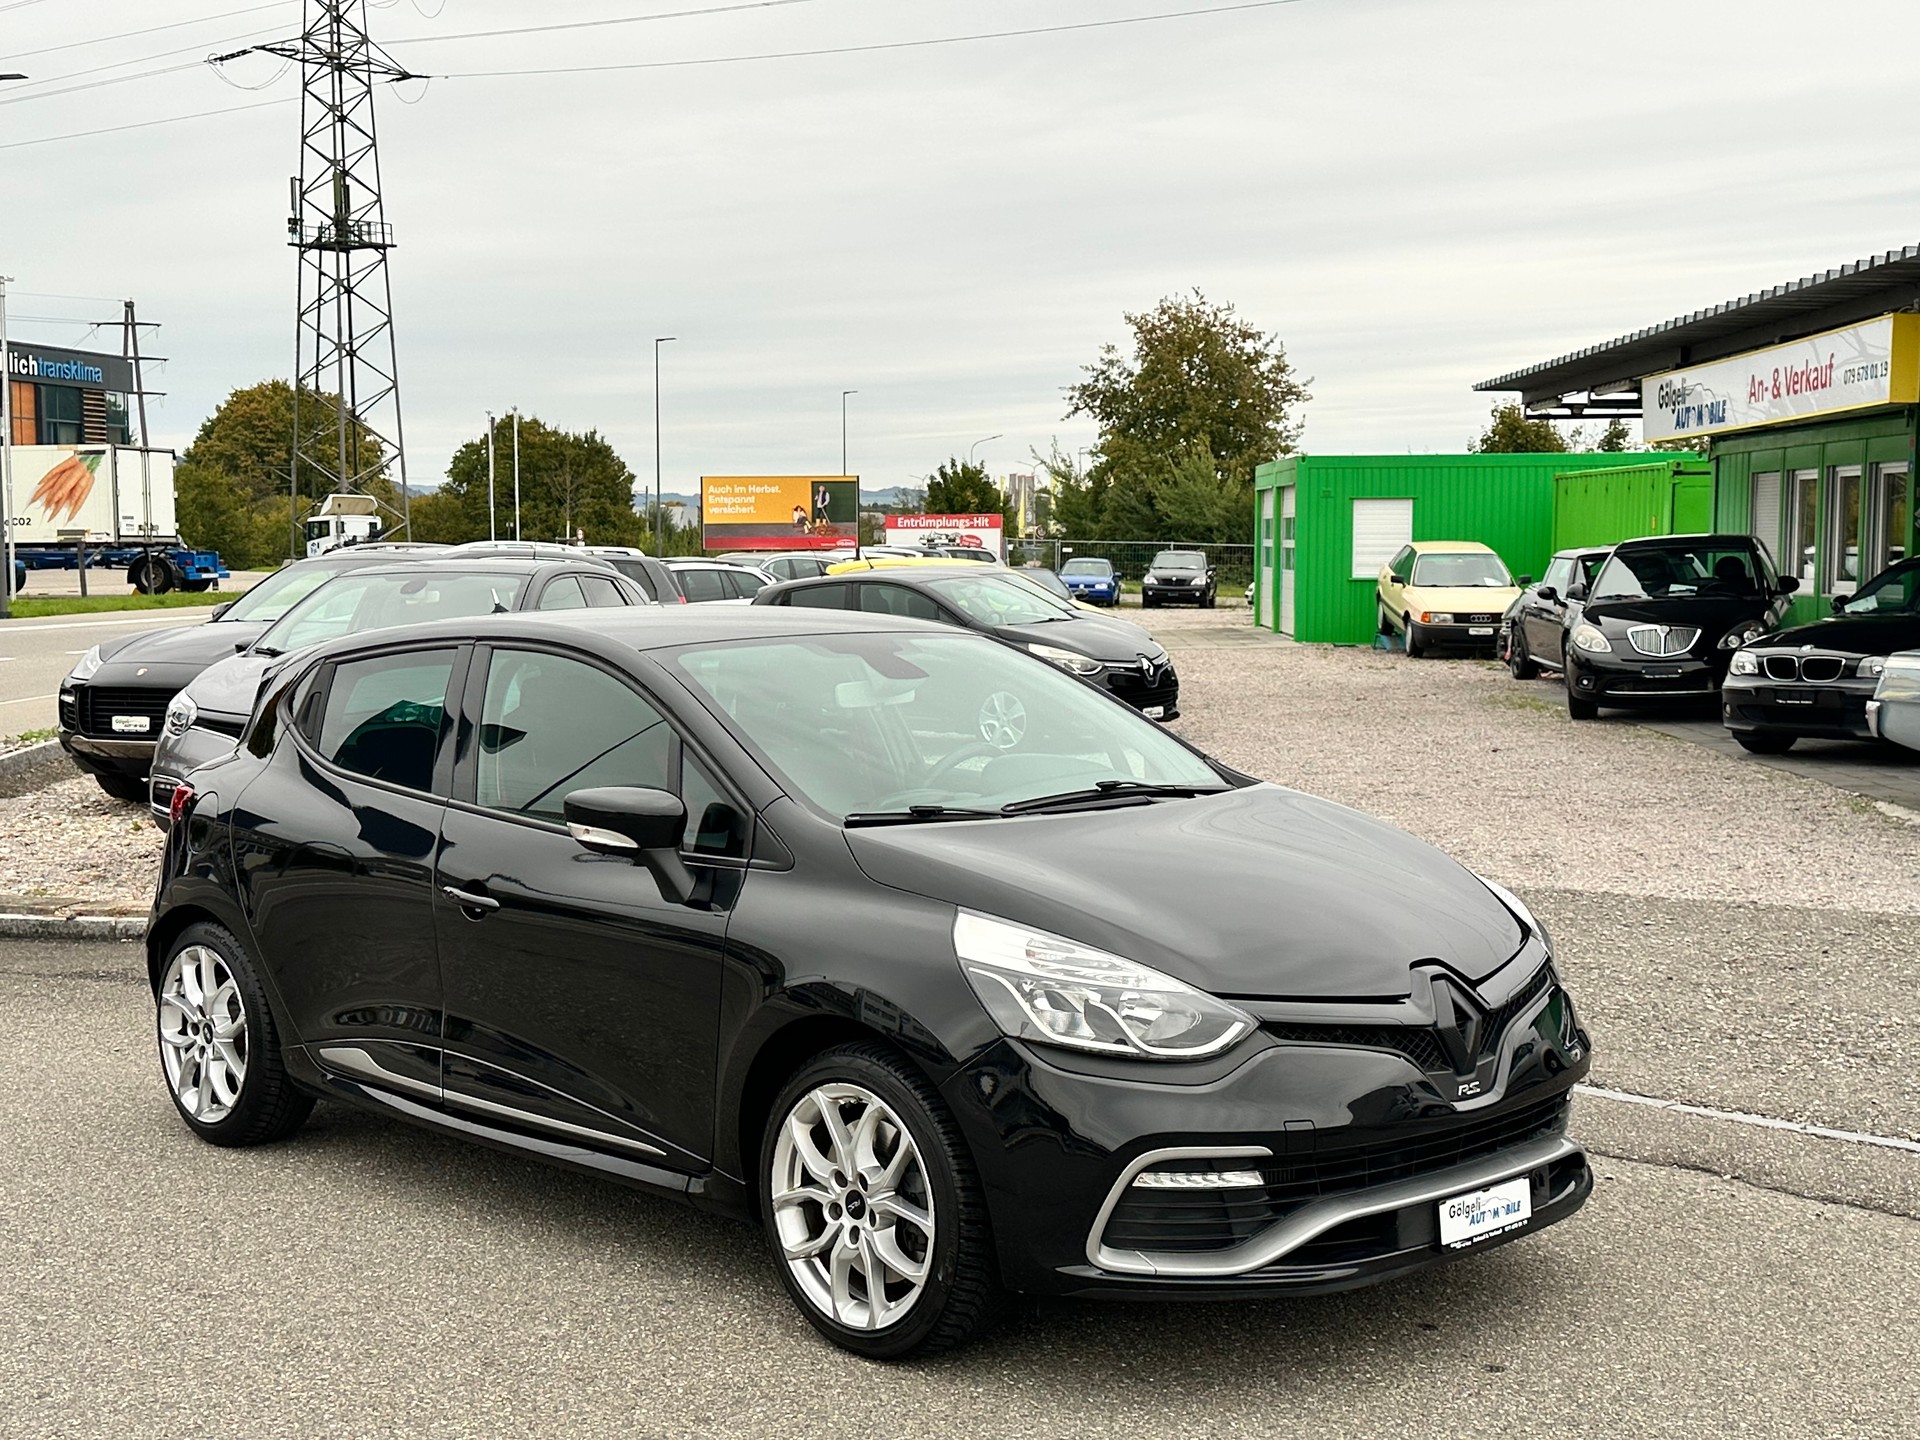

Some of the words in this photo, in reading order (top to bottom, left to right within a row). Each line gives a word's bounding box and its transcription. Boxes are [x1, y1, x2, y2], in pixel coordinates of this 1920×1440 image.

[0, 351, 103, 384] lichtransklima
[1749, 374, 1768, 404] An-
[1772, 367, 1781, 399] &
[1784, 352, 1834, 396] Verkauf
[1843, 368, 1855, 385] 079
[1870, 363, 1878, 380] 01
[1880, 360, 1888, 378] 19
[1658, 377, 1686, 414] Gölgeli
[708, 484, 732, 494] Auch
[734, 484, 746, 494] im
[748, 484, 782, 494] Herbst.
[708, 495, 755, 505] Entspannt
[709, 504, 757, 514] versichert.
[897, 516, 989, 529] Entrümplungs-Hit
[1449, 1197, 1481, 1218] Gölgeli
